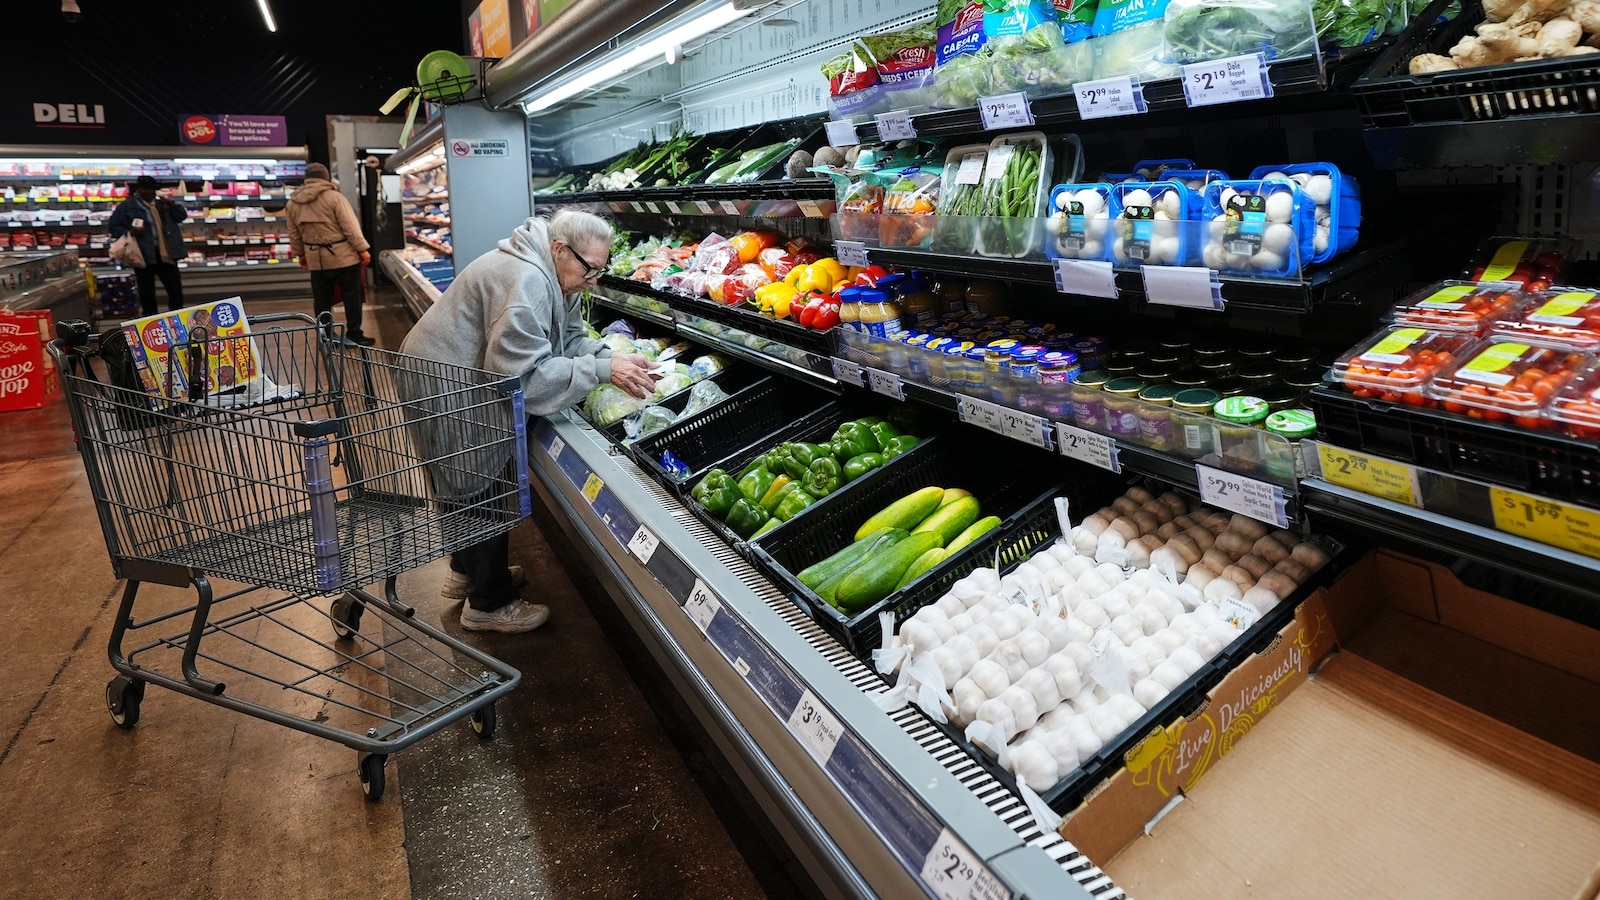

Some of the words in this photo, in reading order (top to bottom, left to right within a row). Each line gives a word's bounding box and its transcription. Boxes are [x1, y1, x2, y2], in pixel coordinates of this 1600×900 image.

[943, 33, 980, 55] CAESAR
[897, 47, 926, 61] Fresh
[1227, 61, 1241, 71] Dole
[33, 102, 106, 124] DELI
[187, 120, 207, 129] Shop
[218, 311, 229, 327] lot
[224, 304, 235, 324] save
[0, 360, 35, 379] ove
[1371, 466, 1383, 475] Hot
[1385, 471, 1406, 482] House
[1241, 479, 1254, 490] Spice
[1256, 483, 1272, 494] World
[1372, 475, 1402, 489] Tomatoes
[1244, 495, 1258, 506] Garlic
[1565, 515, 1590, 528] Grape
[1176, 729, 1214, 775] Live
[1219, 647, 1302, 734] Deliciously
[820, 722, 829, 734] Fresh
